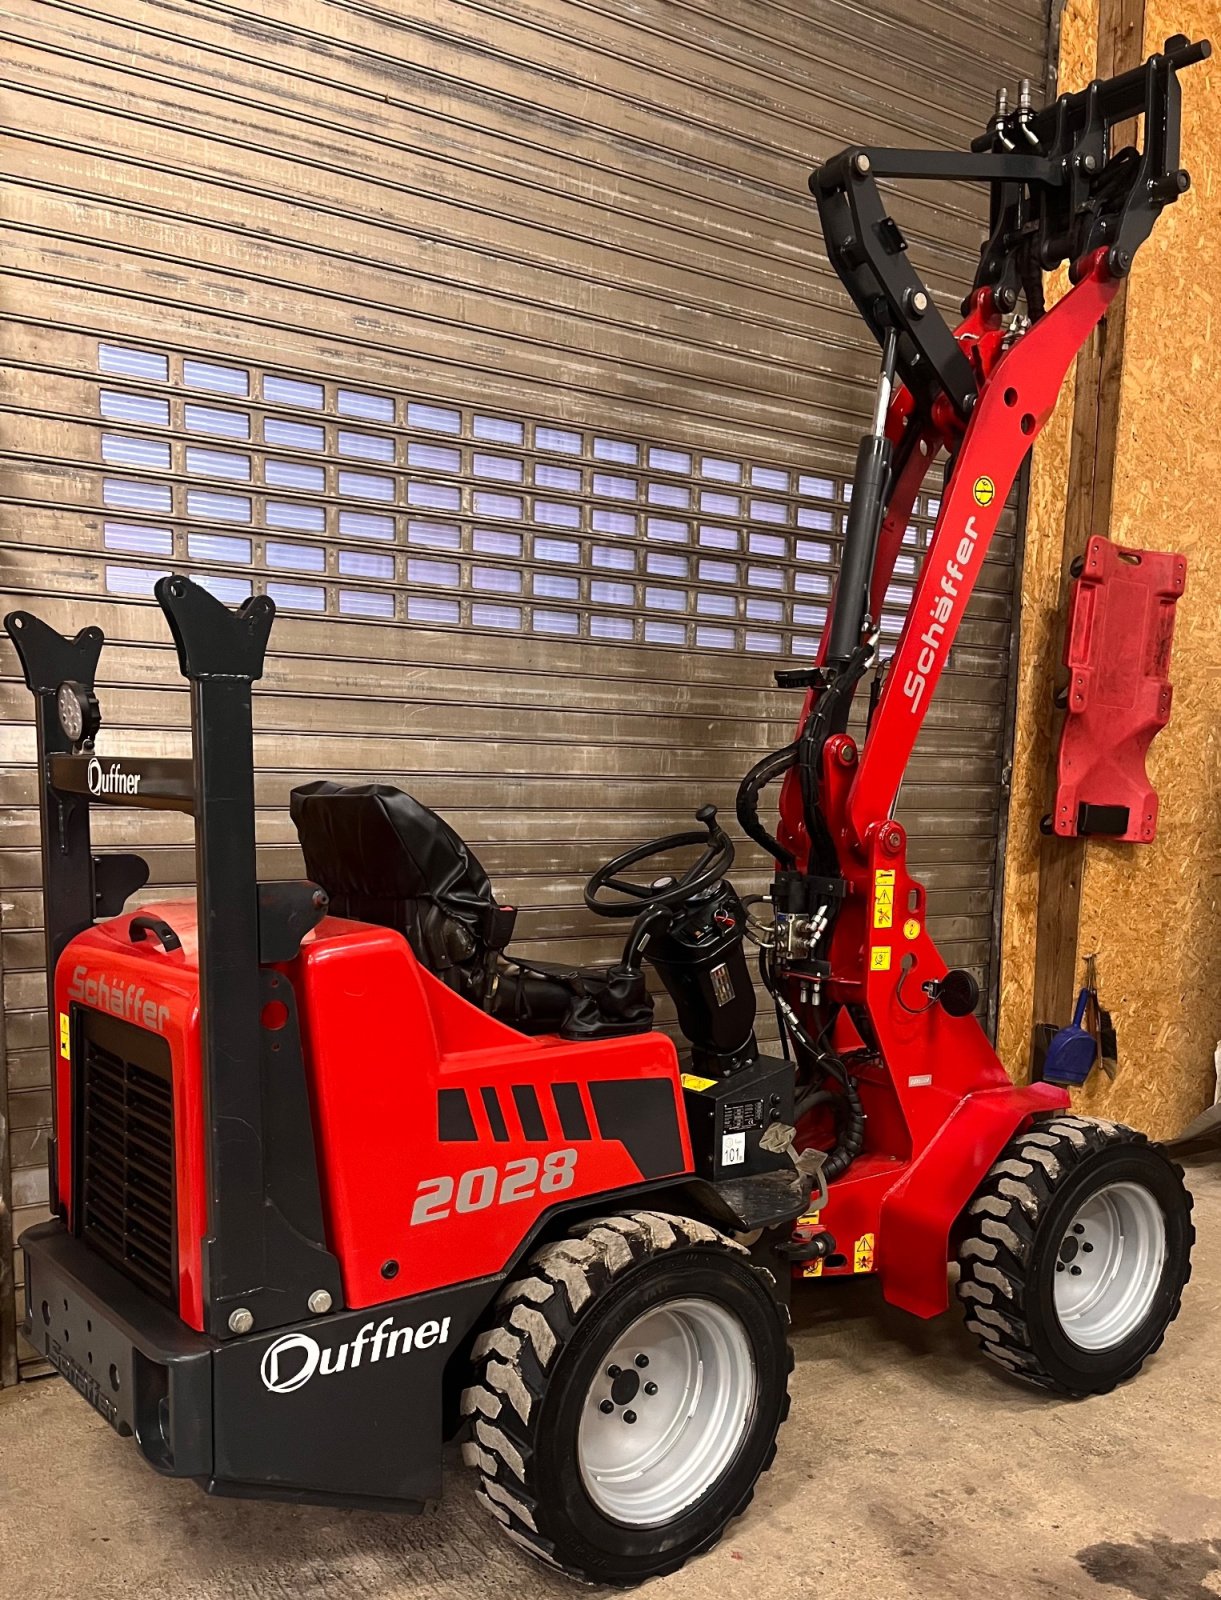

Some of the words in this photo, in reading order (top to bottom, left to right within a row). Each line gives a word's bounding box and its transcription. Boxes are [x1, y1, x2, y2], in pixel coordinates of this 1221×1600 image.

[903, 515, 979, 714] Schäffer
[87, 757, 141, 796] Duffner
[67, 964, 170, 1032] Schäffer
[409, 1147, 578, 1226] 2028
